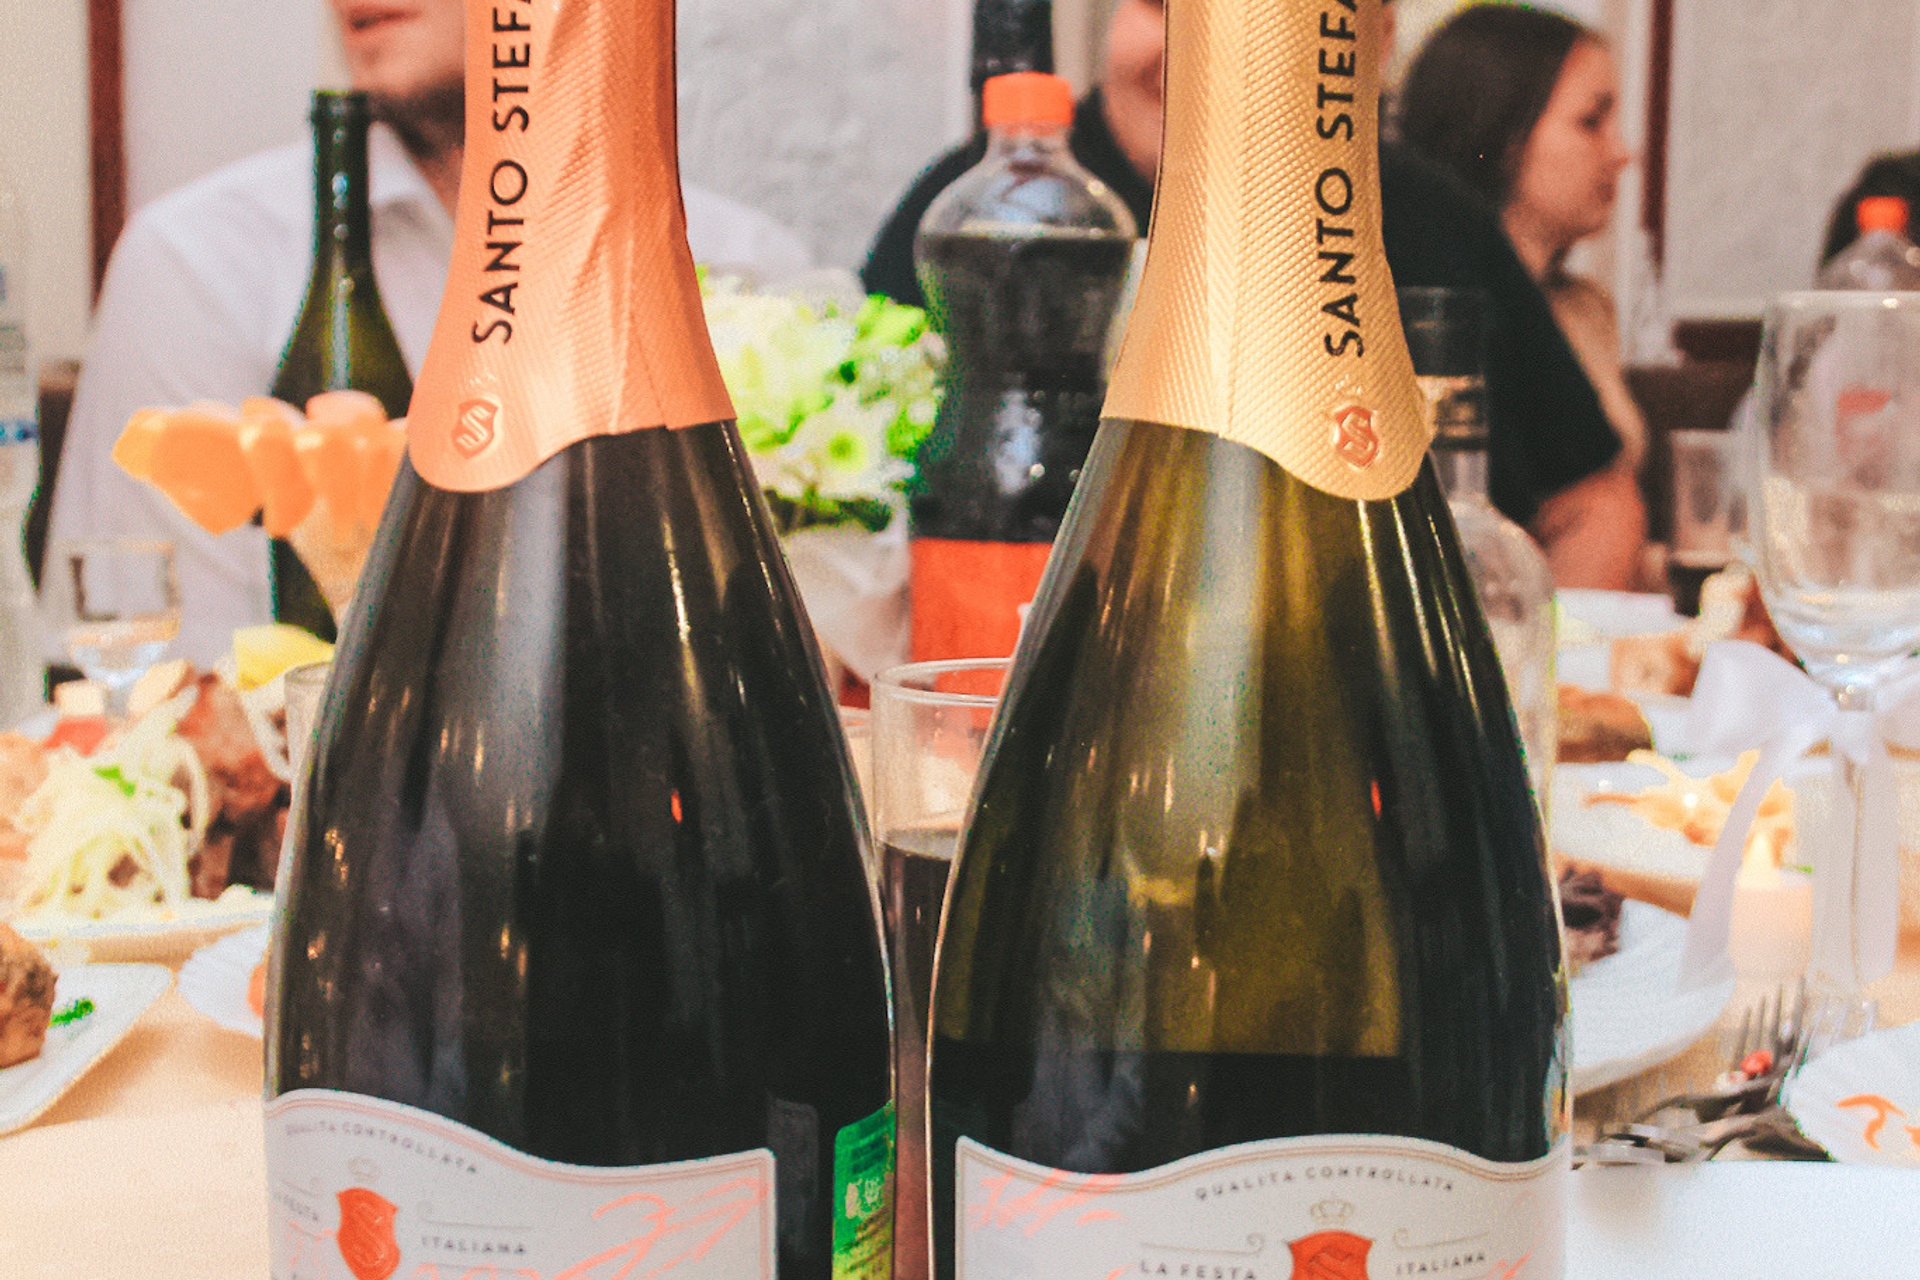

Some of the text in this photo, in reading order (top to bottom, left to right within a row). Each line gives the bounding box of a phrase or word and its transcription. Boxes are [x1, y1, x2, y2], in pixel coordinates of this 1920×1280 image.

[472, 0, 531, 346] SANTO STEF
[1314, 168, 1363, 357] SANTO
[342, 1121, 478, 1174] CONTROLLATA
[1195, 1165, 1452, 1200] QUALITA CONTROLLATA
[421, 1235, 528, 1255] ITALIANA
[1395, 1249, 1487, 1276] ITALIANA
[1139, 1258, 1257, 1280] LA FESTA
